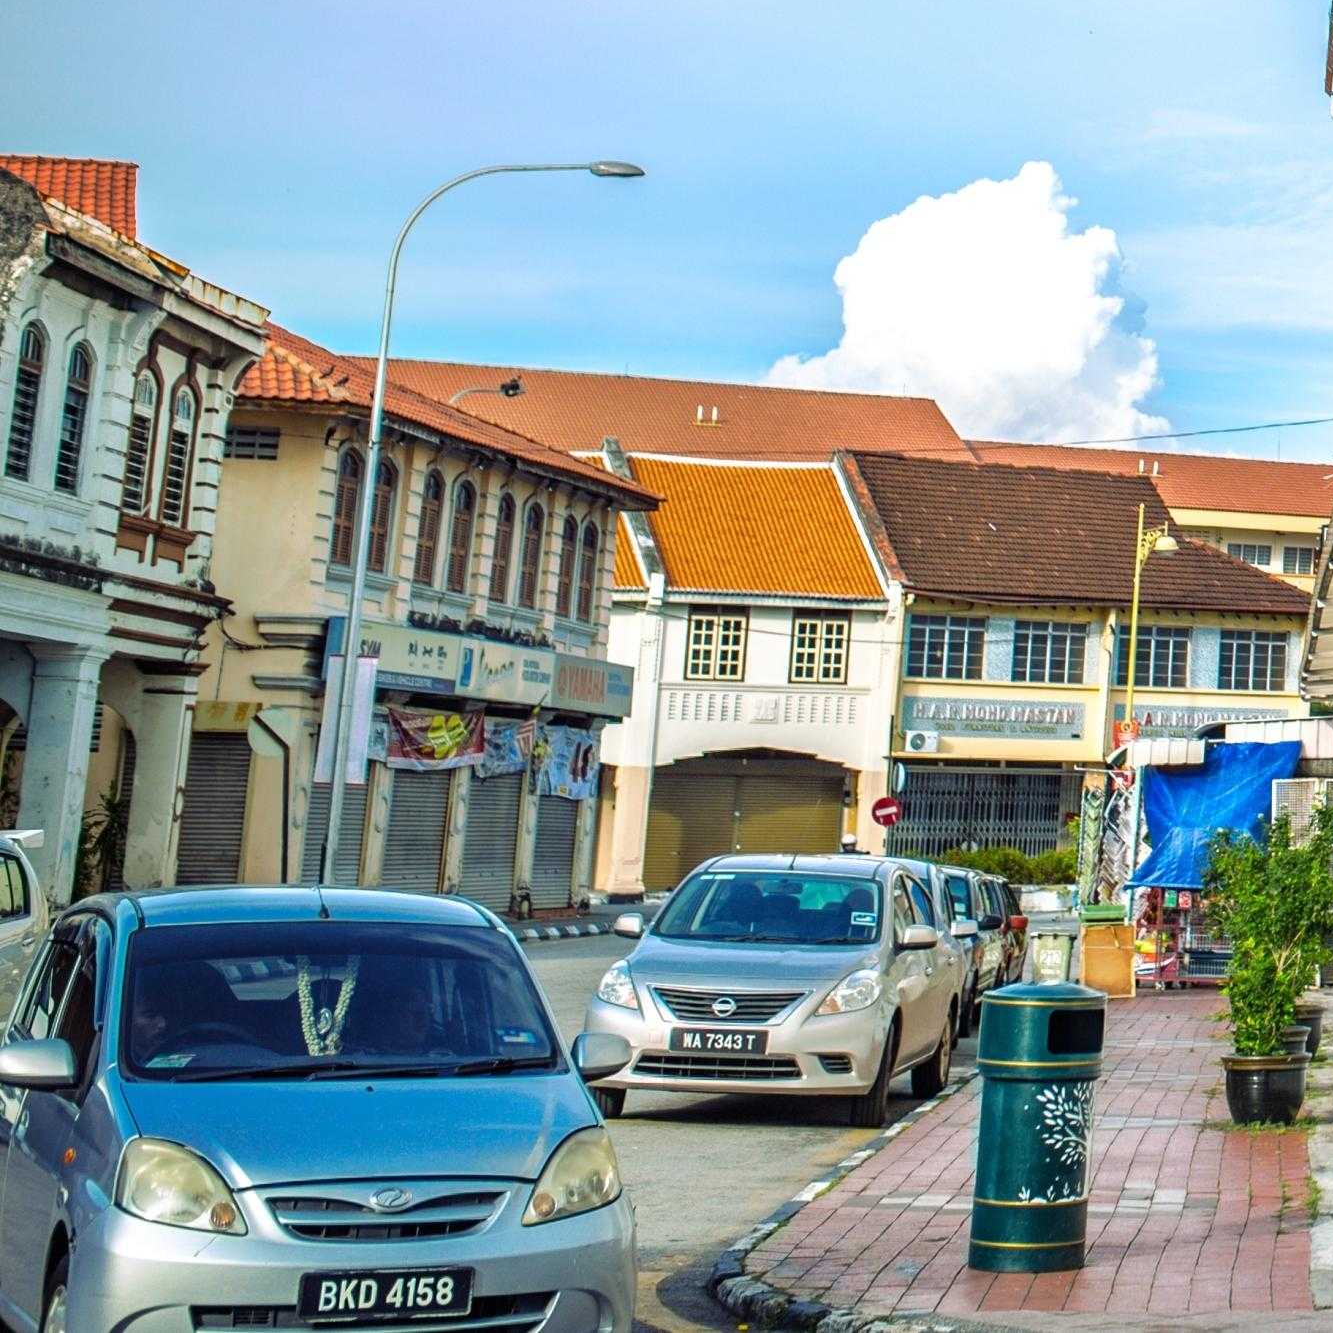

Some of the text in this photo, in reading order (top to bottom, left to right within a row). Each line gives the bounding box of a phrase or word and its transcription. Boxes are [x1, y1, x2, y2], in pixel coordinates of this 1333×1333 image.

[682, 1032, 756, 1051] WA 7343 T
[318, 1276, 454, 1312] BKD 4158
